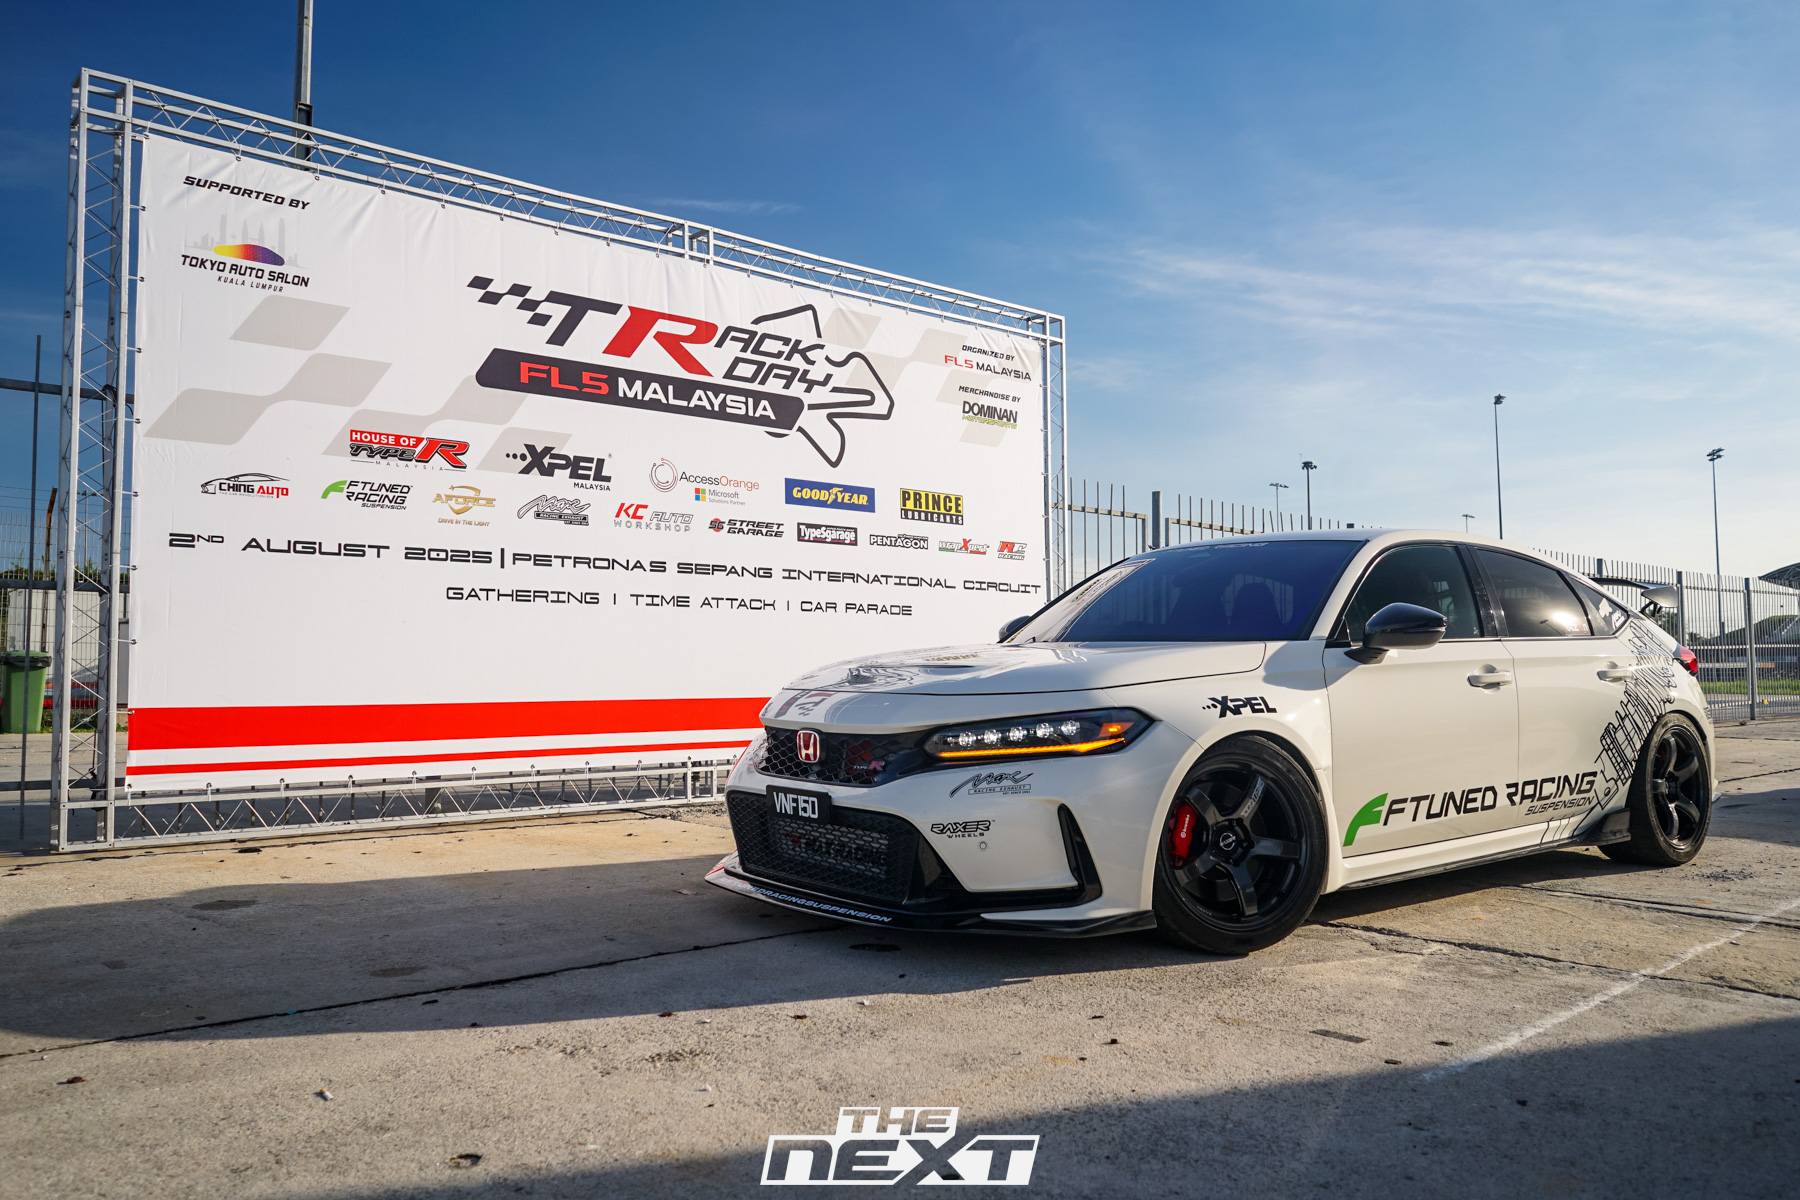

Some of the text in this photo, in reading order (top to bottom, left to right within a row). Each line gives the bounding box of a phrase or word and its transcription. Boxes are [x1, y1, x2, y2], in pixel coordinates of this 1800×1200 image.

[183, 175, 310, 210] SUPPORTED BY
[181, 254, 310, 288] TOKYO AUTO SALON
[217, 276, 283, 292] KUALA LUMPUR
[961, 344, 1005, 360] ORGANIZED
[722, 356, 833, 394] DAY
[944, 354, 1032, 381] FL5 MALAYSIA
[519, 361, 776, 420] FL5 MALAYSIA
[958, 385, 1021, 403] MERCHANDISE BY
[962, 400, 1018, 424] DOMINAN
[351, 432, 417, 446] HOUSE OF
[349, 437, 470, 469] TYPE R
[375, 460, 444, 471] MALAYSIA
[518, 443, 612, 483] XPEL
[219, 482, 255, 494] CHING
[257, 485, 289, 499] AUTO
[347, 480, 411, 494] FTUNED
[573, 482, 611, 492] MALAYSIA
[679, 471, 760, 492] AccessOrange
[346, 491, 407, 505] RACING
[708, 489, 739, 500] Microsoft
[792, 486, 868, 505] GOODYEAR
[901, 490, 962, 514] PRINCE
[361, 502, 407, 511] SUSPENSION
[615, 502, 693, 525] KC AUTO
[613, 519, 691, 533] WORKSHOP
[726, 518, 784, 530] STREET
[901, 510, 963, 525] LUBRICANTS
[726, 527, 784, 538] GARAGE
[869, 534, 928, 550] PENTAGON
[169, 532, 1041, 595] 2ND AUGUST 2025 PETRONAS SEPANG INTERNATIONAL CIRCUIT
[446, 586, 912, 616] GATHERING TIME ATTACK CAR PARADE
[1207, 695, 1277, 718] XPEL
[1383, 771, 1598, 826] FTUNED RACING
[1524, 796, 1596, 816] SUSPENSION
[930, 820, 992, 834] RAXER
